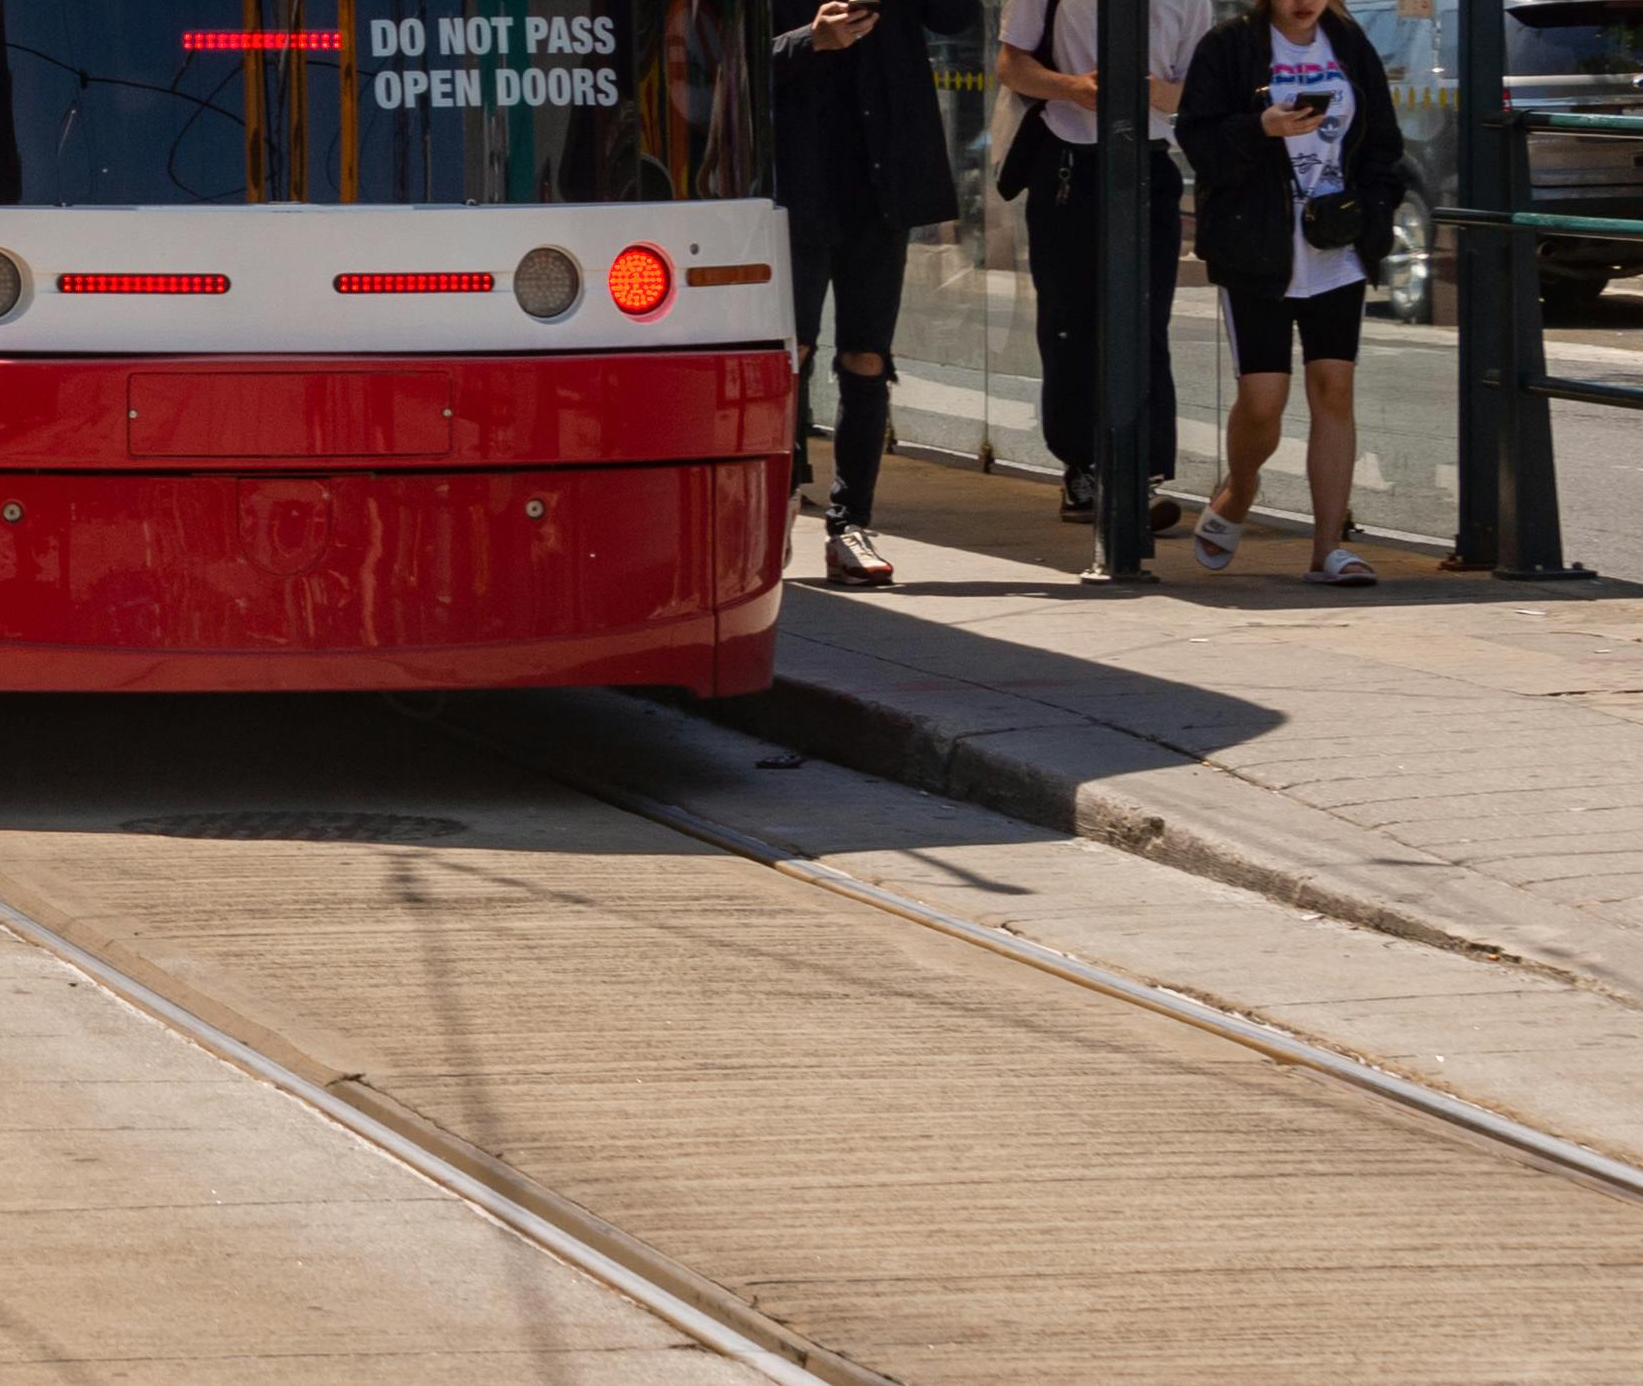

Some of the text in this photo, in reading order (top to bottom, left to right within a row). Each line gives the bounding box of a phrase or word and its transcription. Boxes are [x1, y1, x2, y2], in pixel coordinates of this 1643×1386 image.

[370, 16, 616, 57] DO NOT PASS
[374, 68, 619, 110] OPEN DOORS
